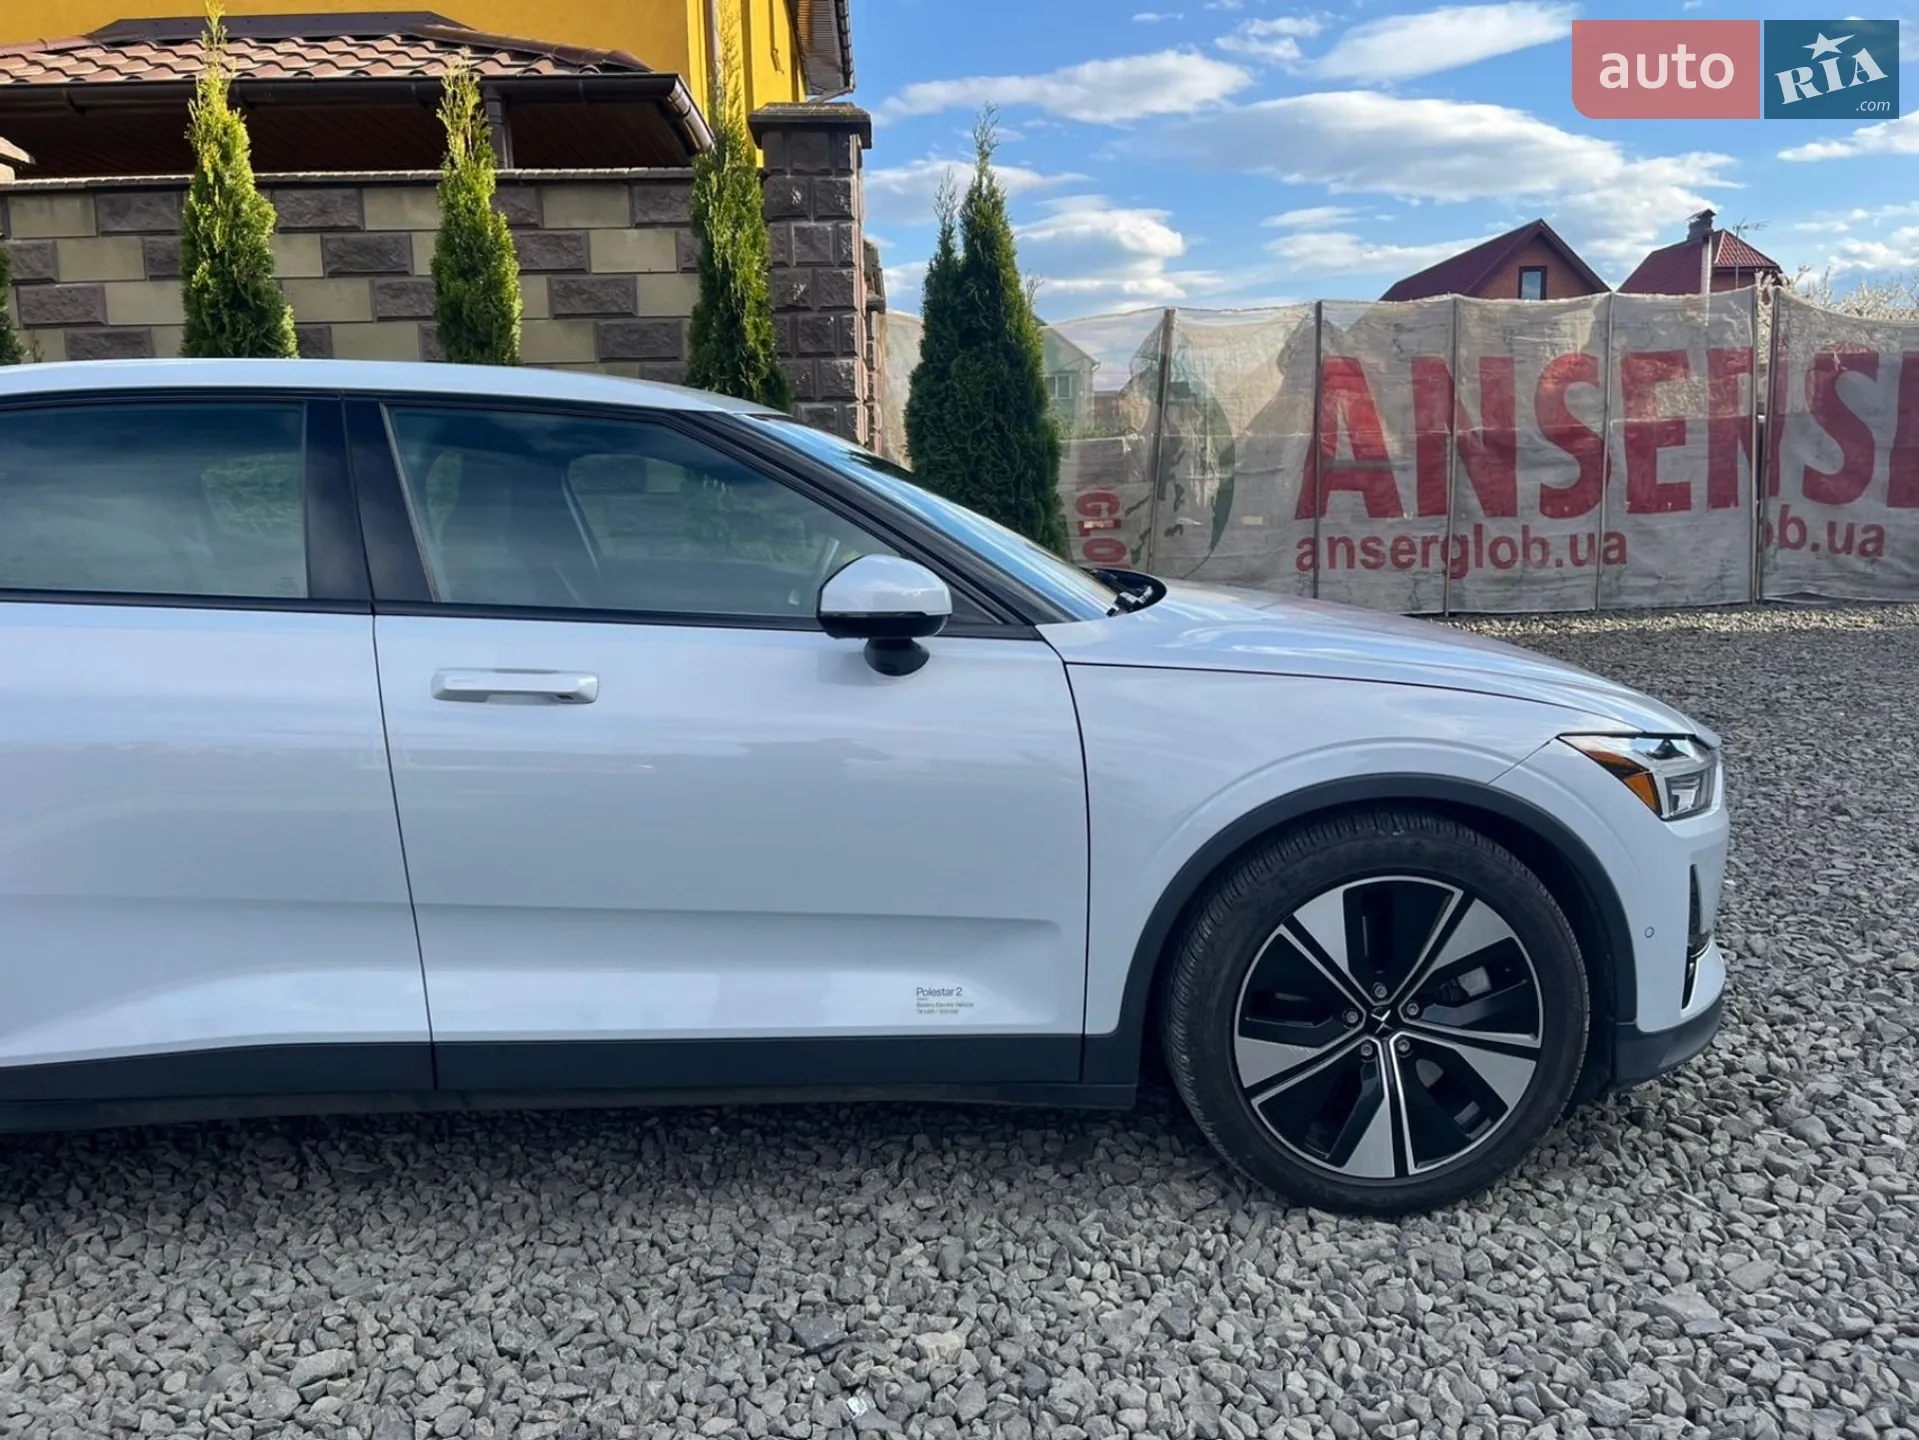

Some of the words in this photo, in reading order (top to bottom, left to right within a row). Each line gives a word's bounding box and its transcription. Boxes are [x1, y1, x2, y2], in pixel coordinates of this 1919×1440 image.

[1295, 523, 1628, 579] anserglob.ua
[916, 987, 954, 997] Polestar
[955, 986, 963, 997] 2
